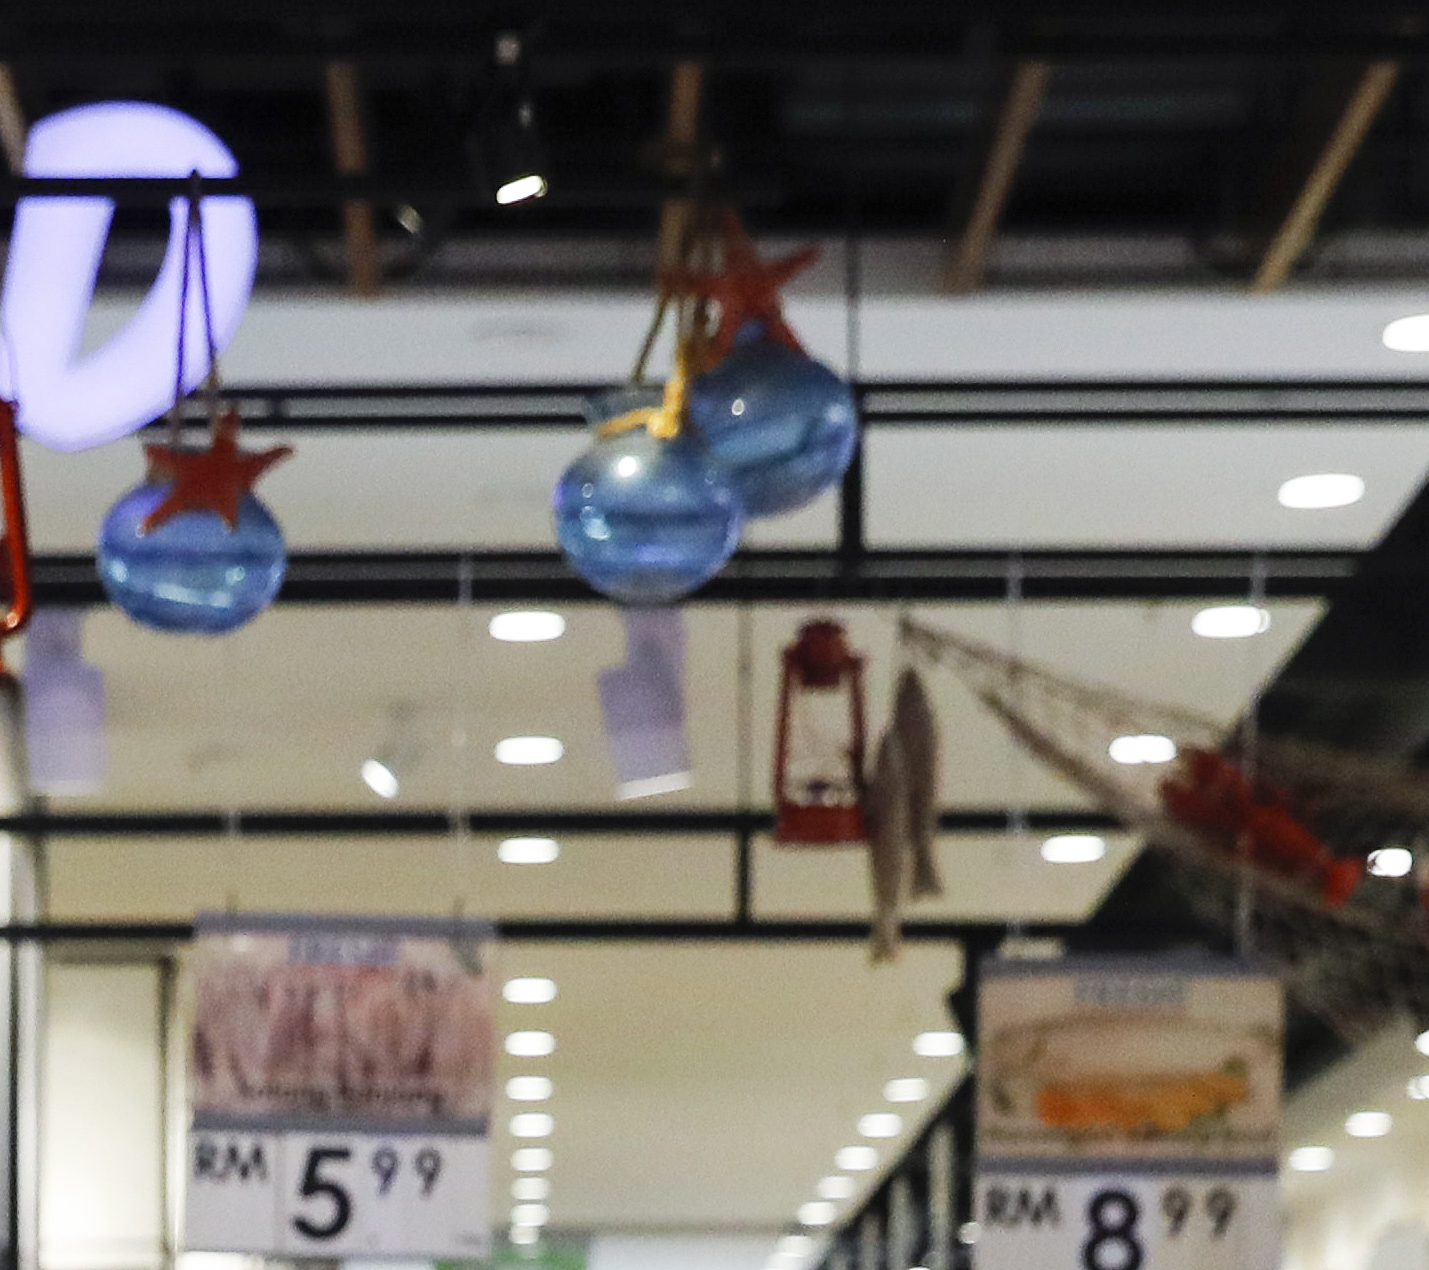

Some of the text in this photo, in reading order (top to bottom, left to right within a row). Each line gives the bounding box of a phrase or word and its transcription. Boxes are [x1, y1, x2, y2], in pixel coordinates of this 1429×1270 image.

[194, 1143, 268, 1181] RM
[291, 1147, 351, 1241] 5
[986, 1187, 1059, 1227] RM
